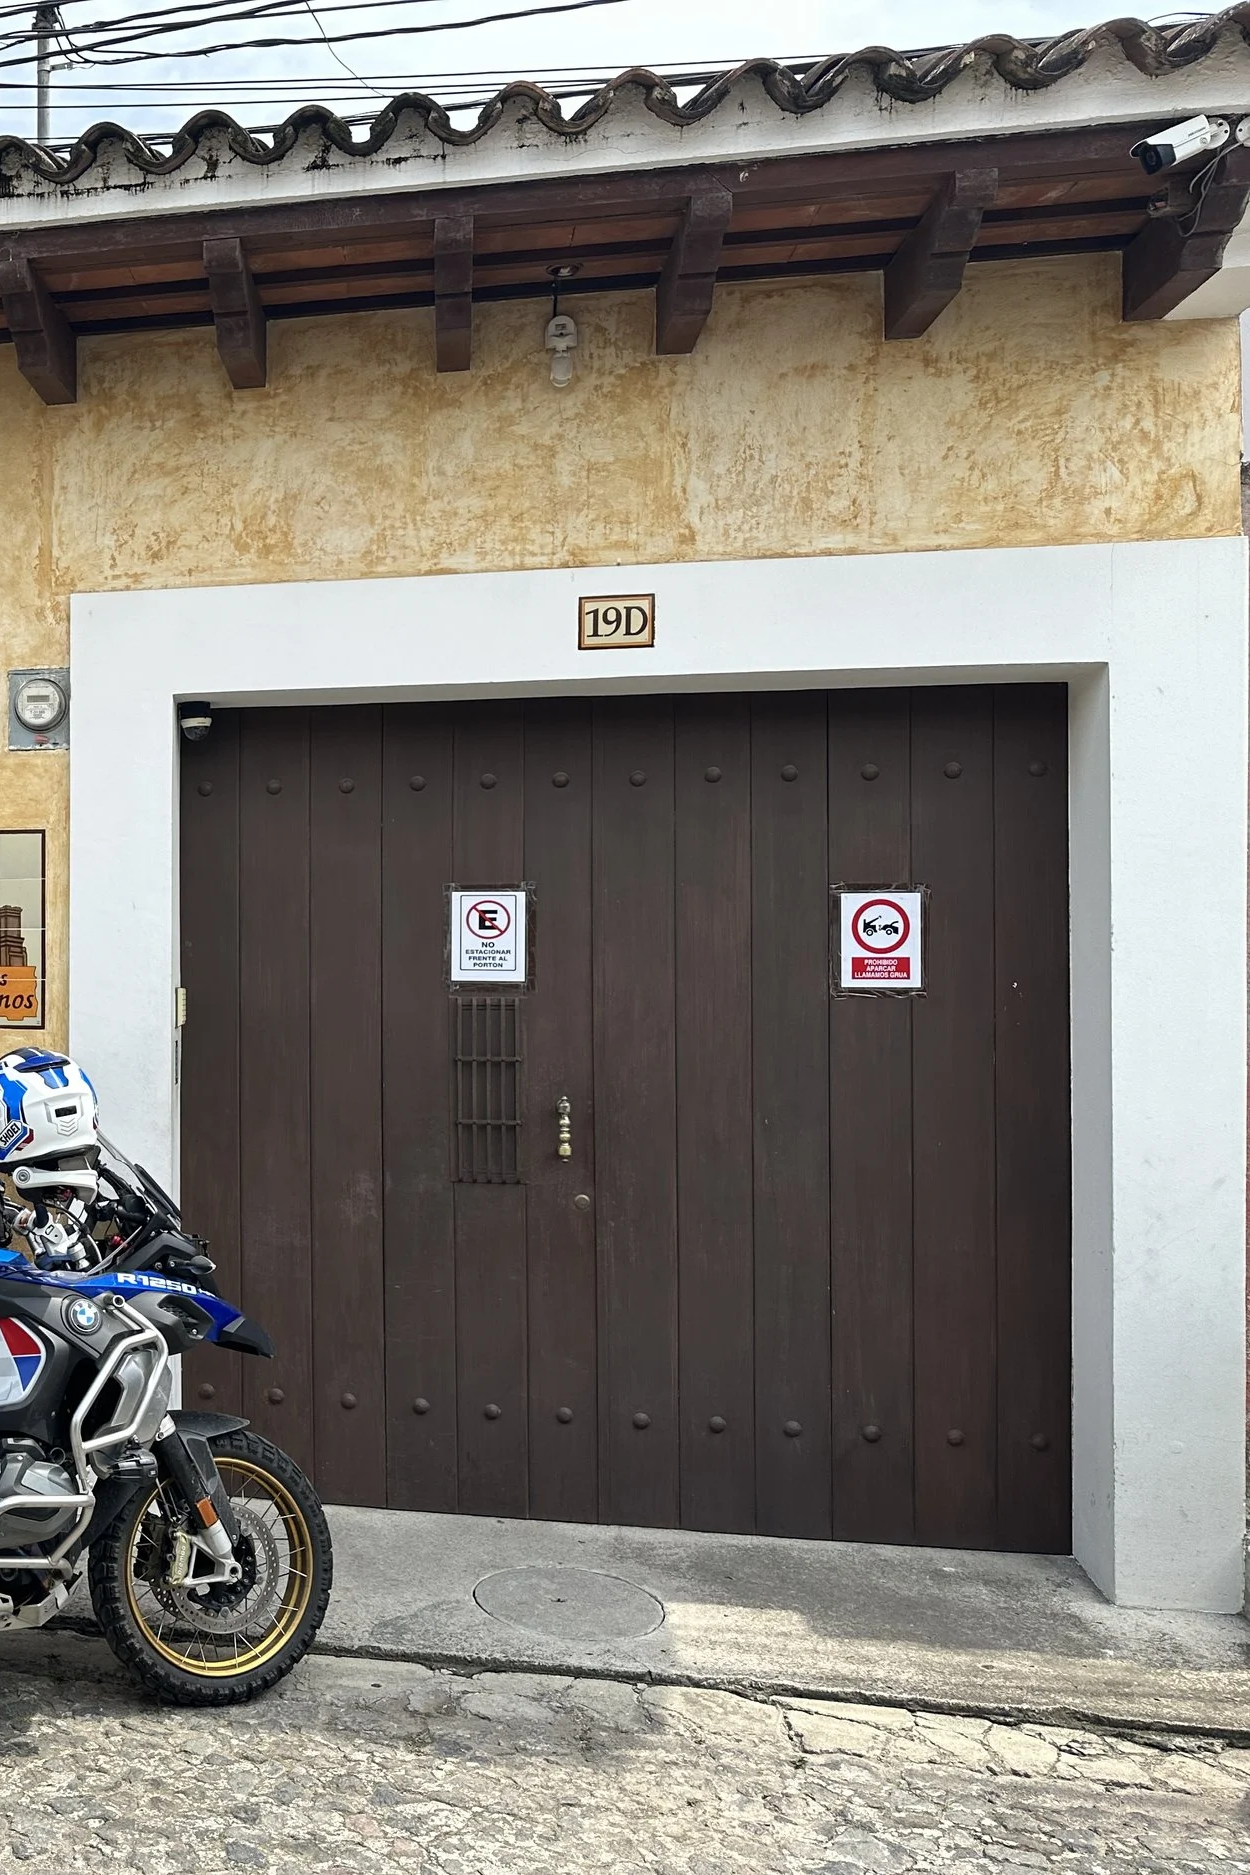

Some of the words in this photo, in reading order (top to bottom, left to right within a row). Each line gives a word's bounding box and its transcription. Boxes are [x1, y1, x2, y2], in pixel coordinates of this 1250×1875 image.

[585, 606, 648, 637] 19D
[478, 909, 498, 930] E
[481, 941, 495, 949] NO
[0, 1122, 21, 1146] SHOEI
[117, 1272, 197, 1295] R1250
